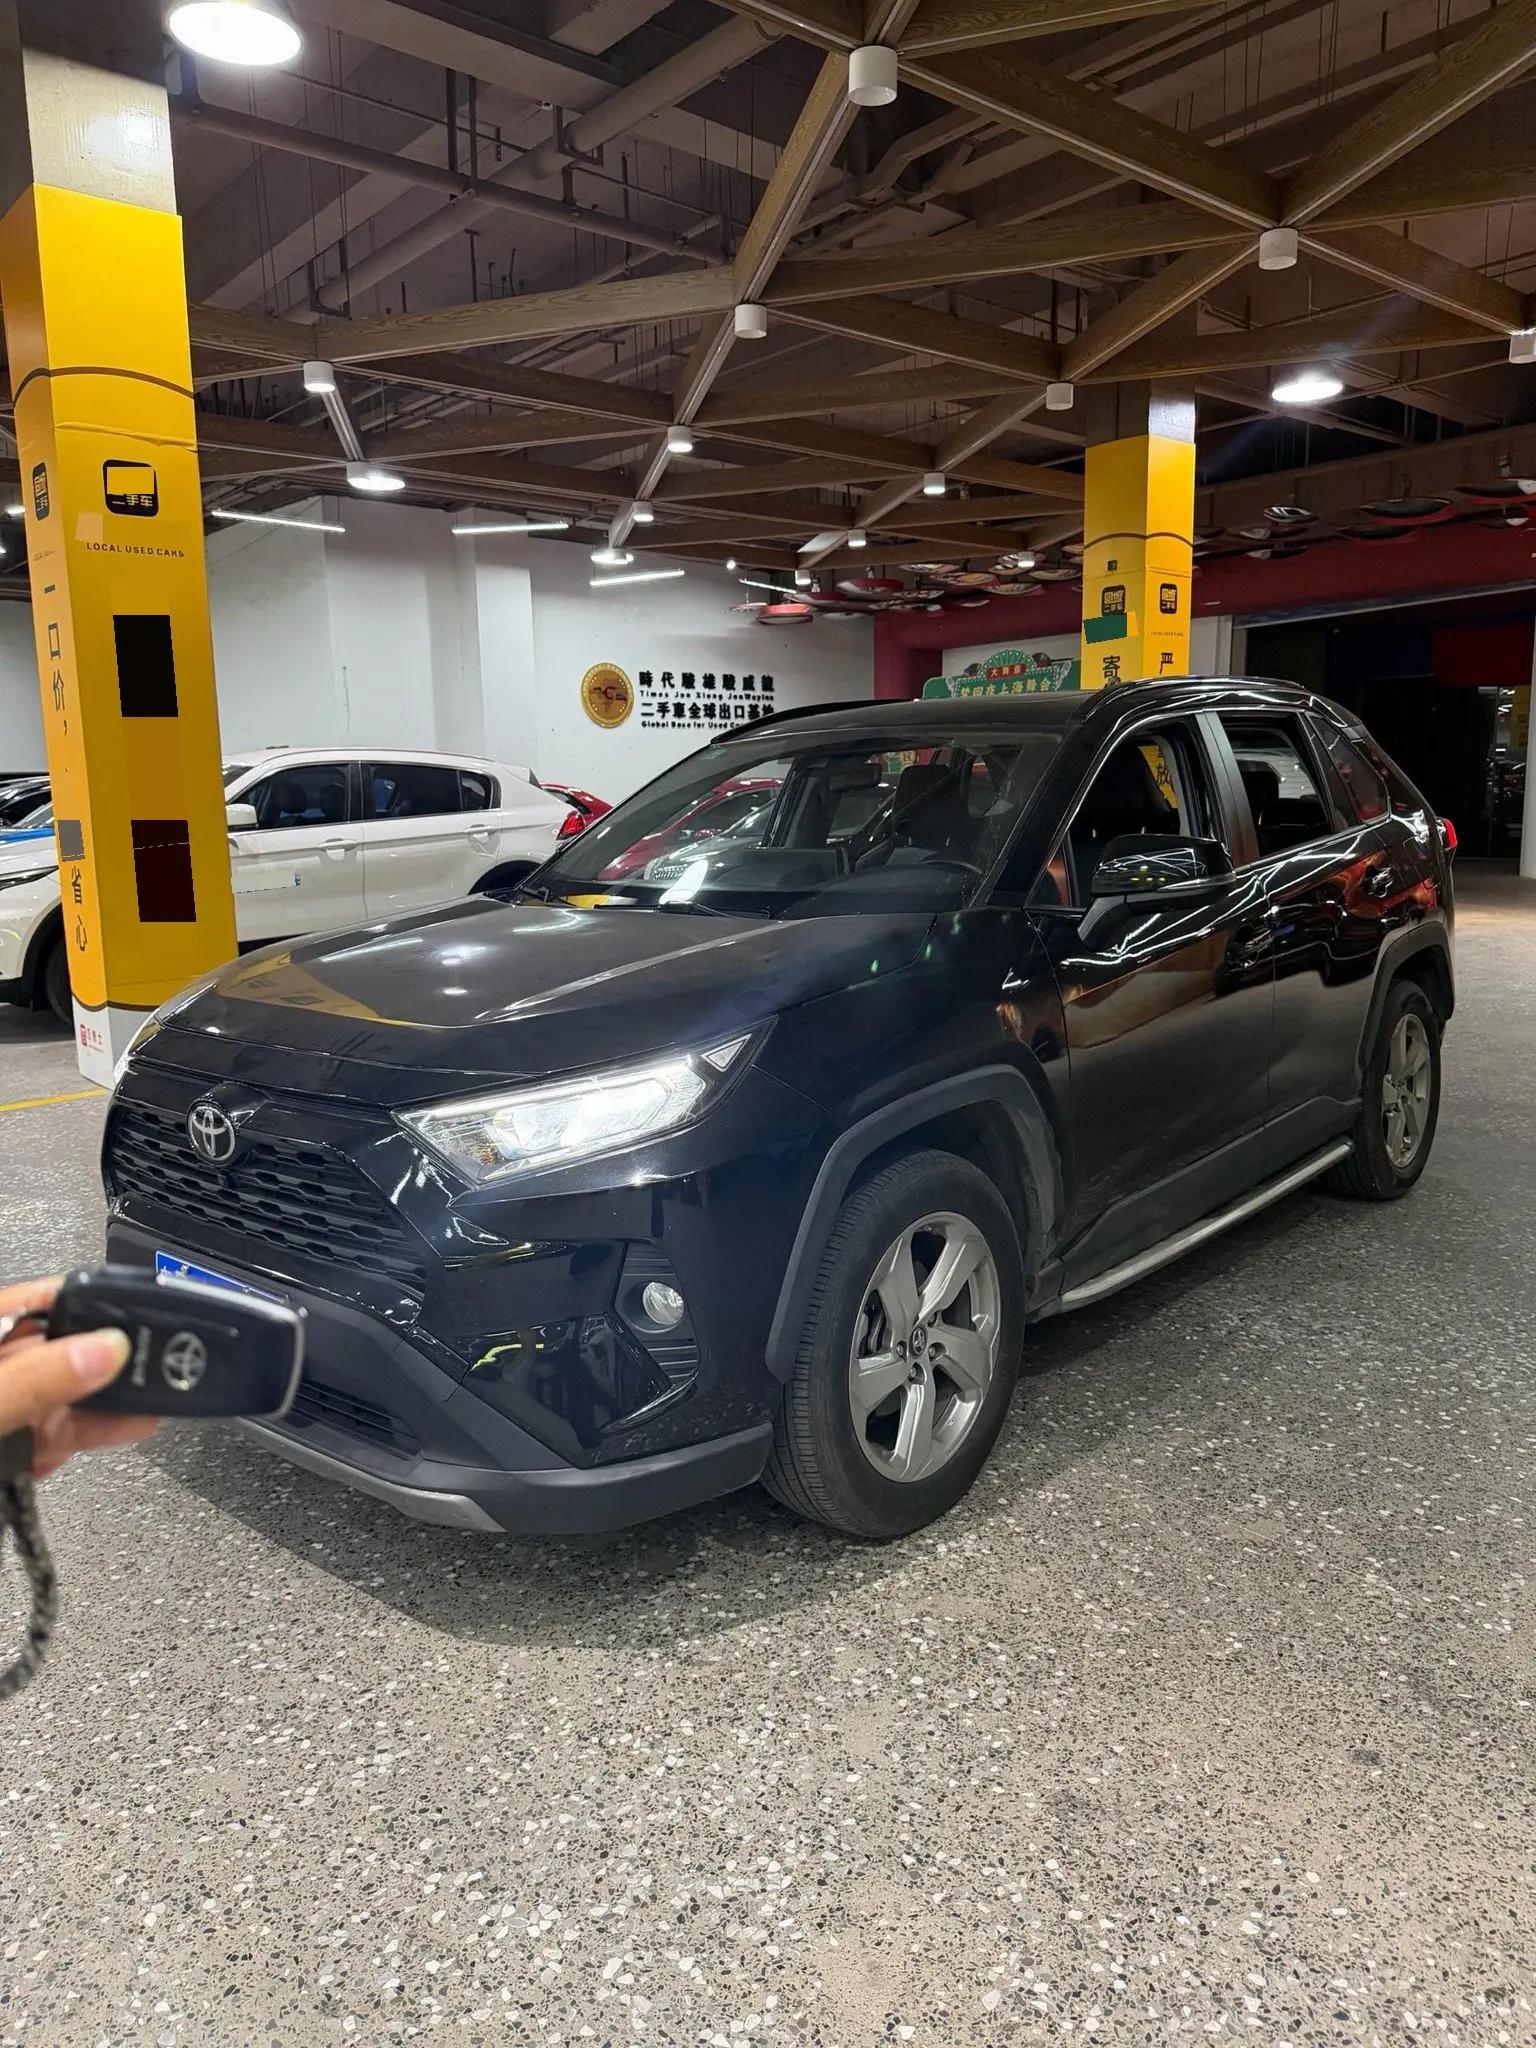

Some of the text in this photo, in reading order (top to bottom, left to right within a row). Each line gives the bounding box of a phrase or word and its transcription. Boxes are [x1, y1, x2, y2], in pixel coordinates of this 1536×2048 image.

[86, 542, 185, 558] LOCAL USED CARS
[1103, 655, 1121, 678] 寄
[1159, 652, 1174, 675] 严
[641, 720, 669, 728] Global
[671, 721, 691, 729] Base
[708, 721, 728, 729] Used
